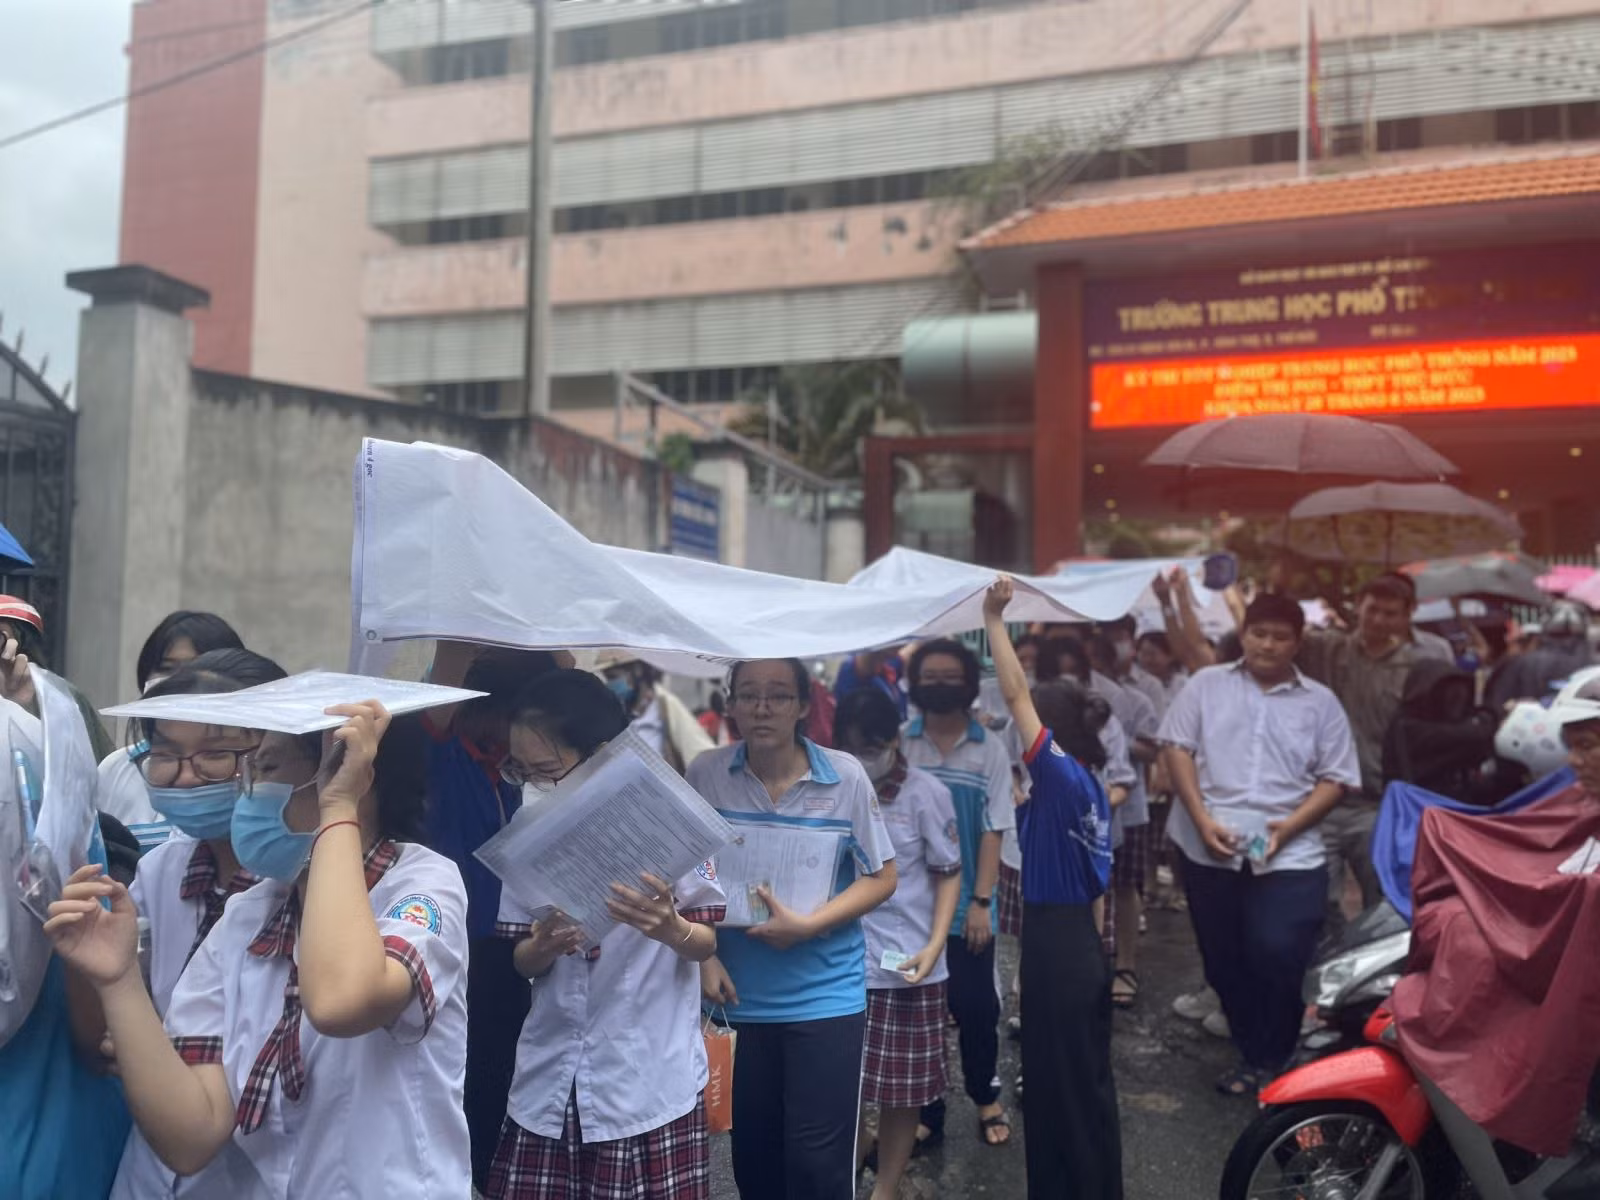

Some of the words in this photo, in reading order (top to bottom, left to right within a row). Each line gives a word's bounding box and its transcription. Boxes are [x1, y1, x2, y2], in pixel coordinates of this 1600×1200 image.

[1208, 295, 1279, 325] TRUNG
[1284, 292, 1332, 323] HỌC
[1337, 275, 1388, 317] PHỔ
[1281, 360, 1340, 378] TRUNG
[711, 1064, 721, 1107] HMK
